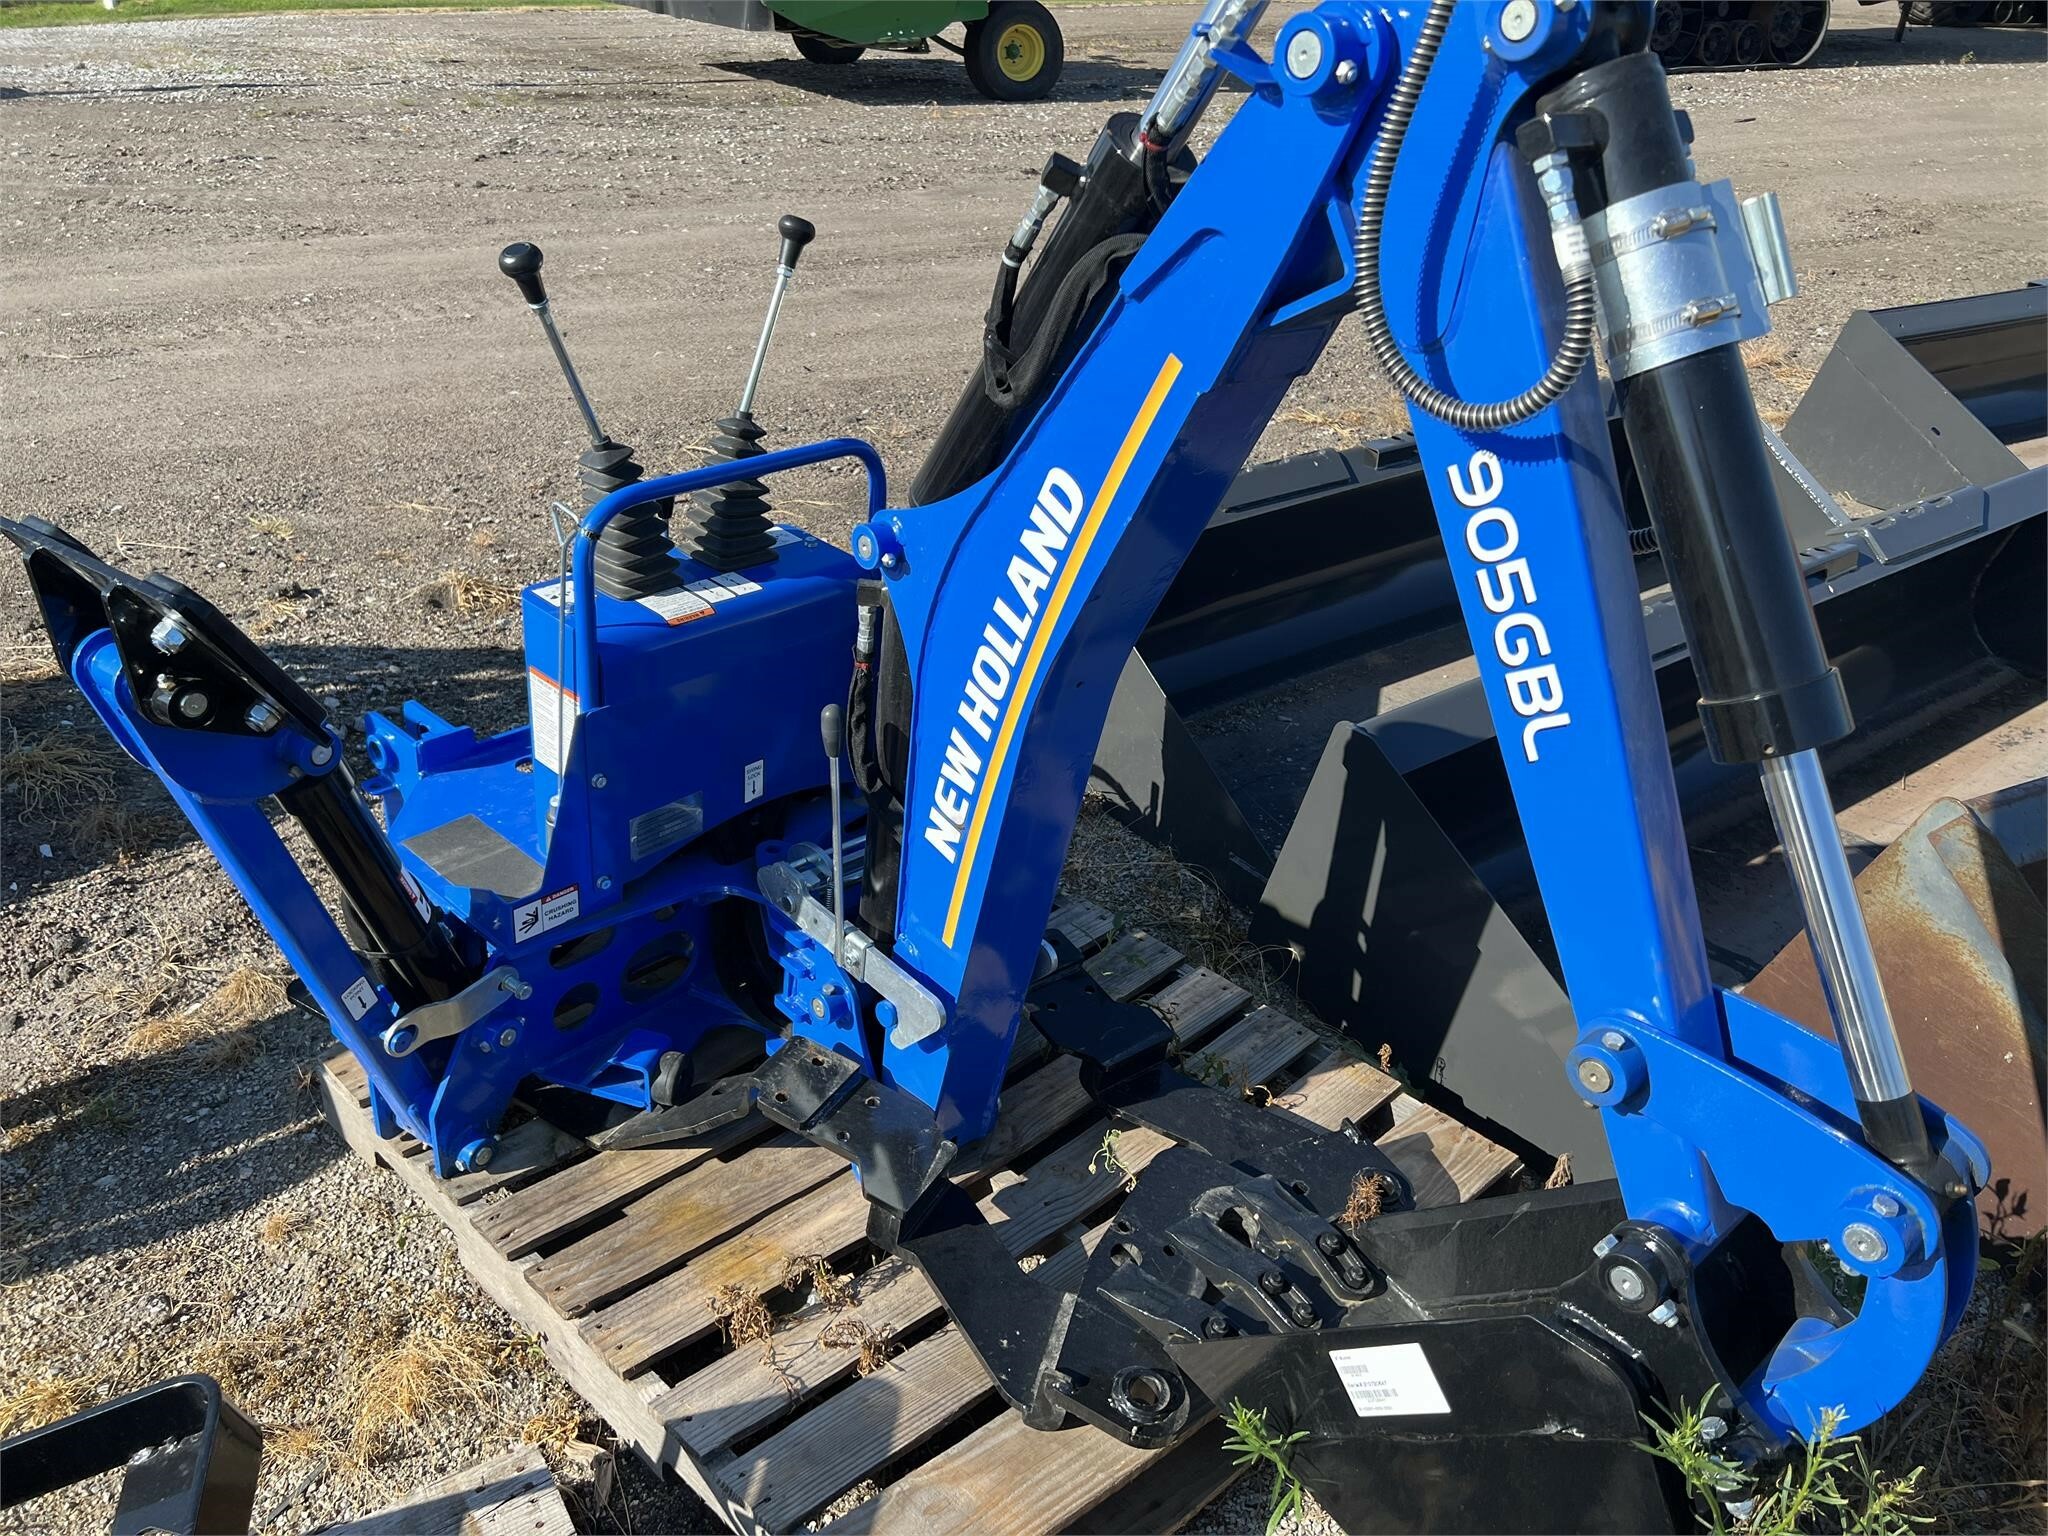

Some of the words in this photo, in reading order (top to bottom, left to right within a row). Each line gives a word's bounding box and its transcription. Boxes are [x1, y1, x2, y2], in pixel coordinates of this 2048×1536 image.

[923, 725, 983, 864] NEW
[957, 466, 1085, 743] HOLLAND
[1447, 449, 1571, 763] 905GBL
[544, 899, 577, 916] CRUSHING
[548, 907, 574, 921] HAZARD
